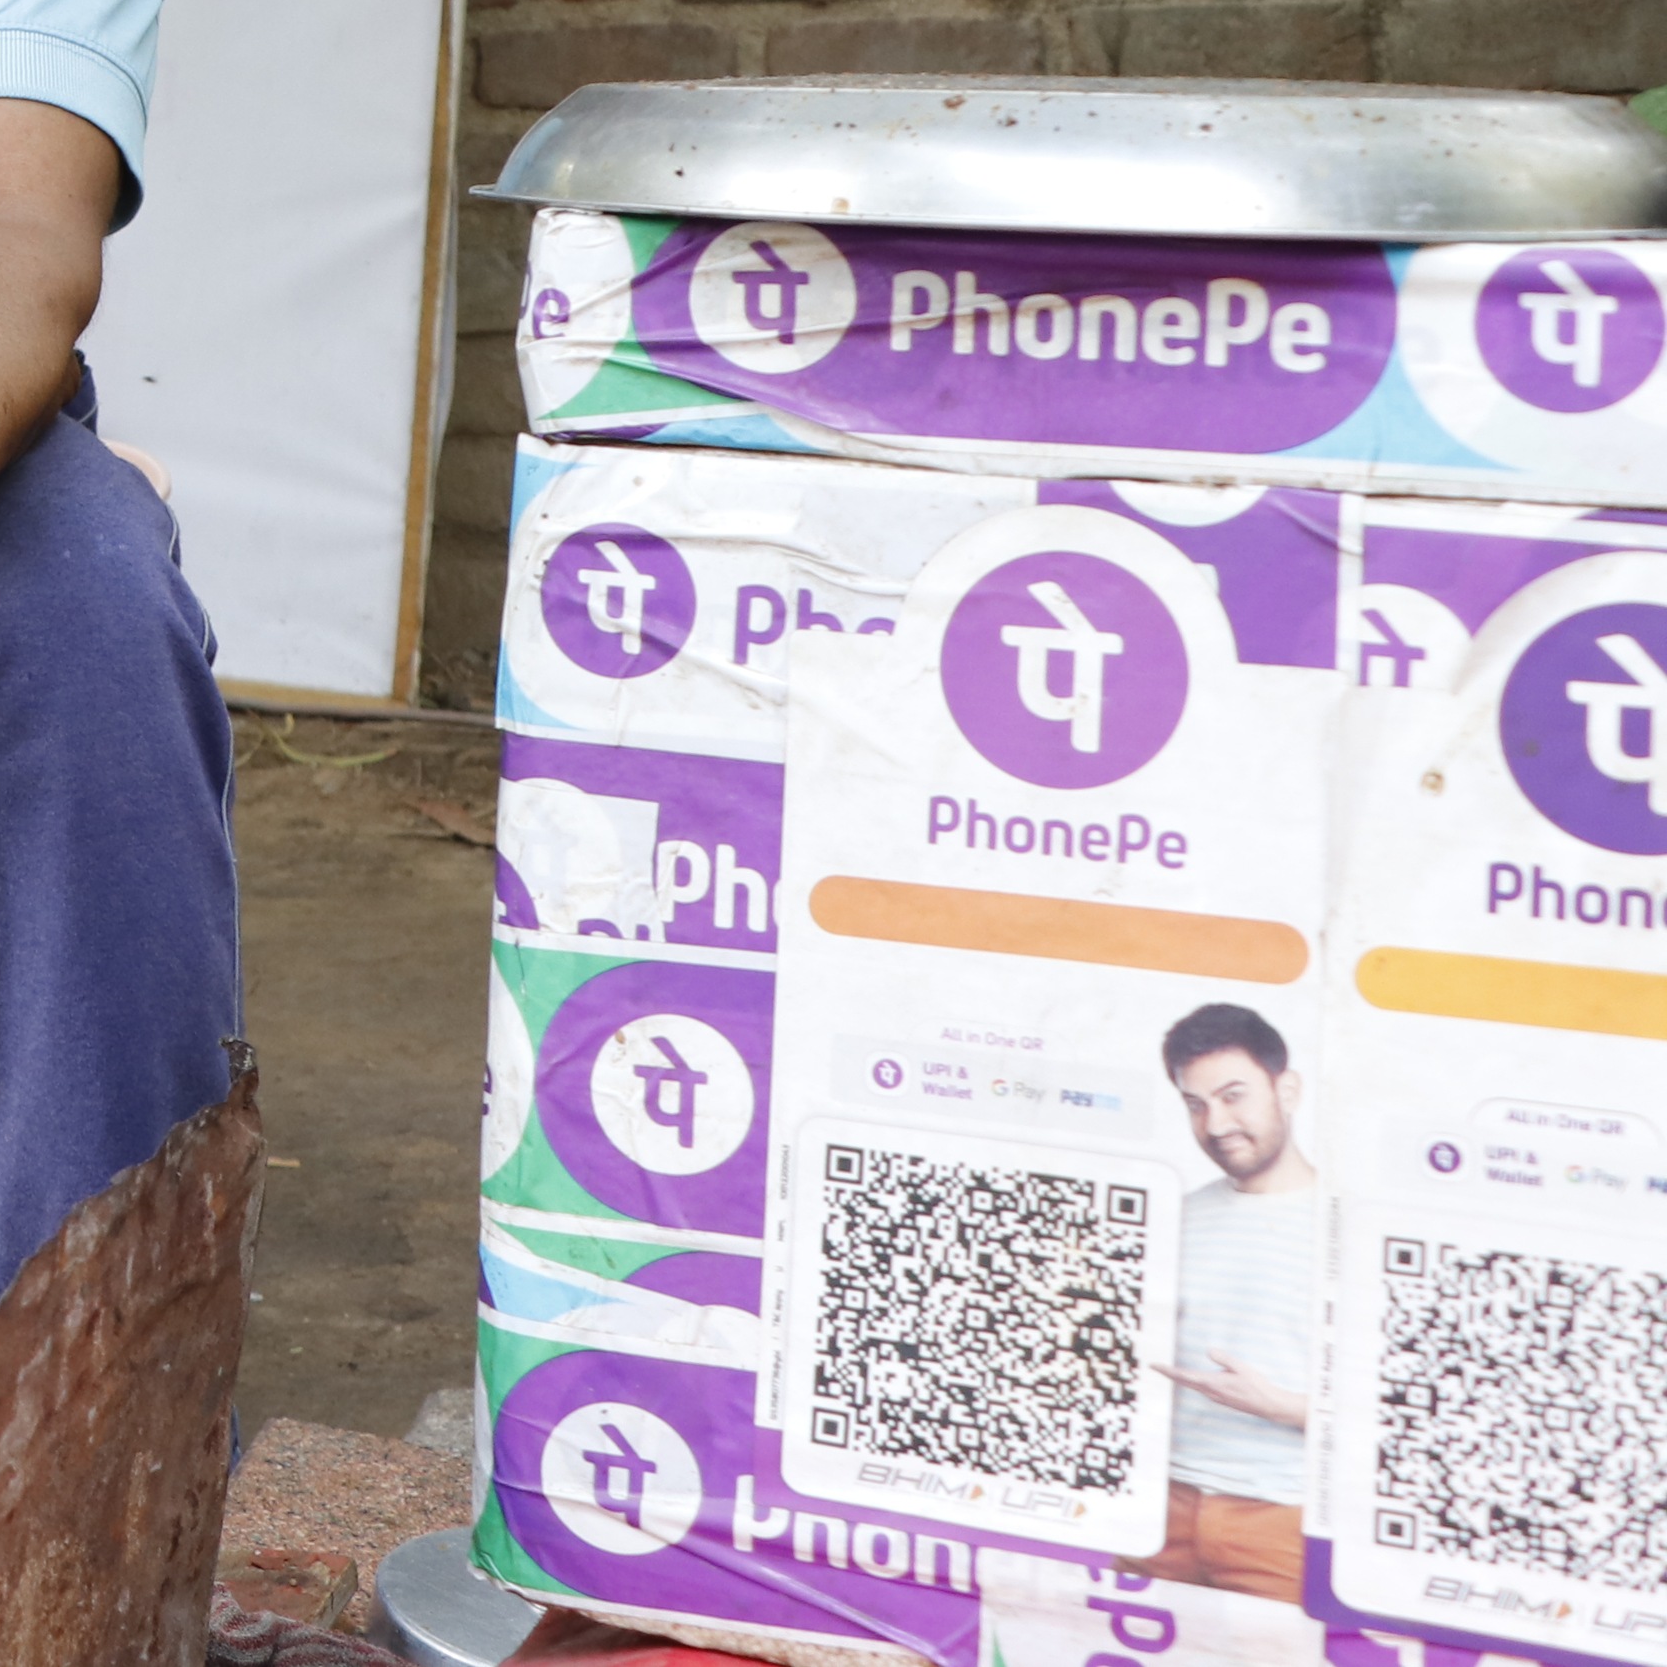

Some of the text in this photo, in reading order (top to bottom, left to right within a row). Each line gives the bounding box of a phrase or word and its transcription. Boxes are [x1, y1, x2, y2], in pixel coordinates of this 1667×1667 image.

[888, 267, 1332, 374] PhonePe
[927, 794, 1189, 870] PhonePe
[656, 838, 781, 934] Ph
[1486, 860, 1667, 932] Phon
[941, 1026, 1045, 1052] All in One QR
[922, 1060, 953, 1078] UPI
[921, 1080, 973, 1101] Wallet
[1014, 1081, 1046, 1104] Pay
[857, 1461, 969, 1500] BHIM
[1000, 1485, 1074, 1517] UPI
[1423, 1575, 1556, 1618] BHIM
